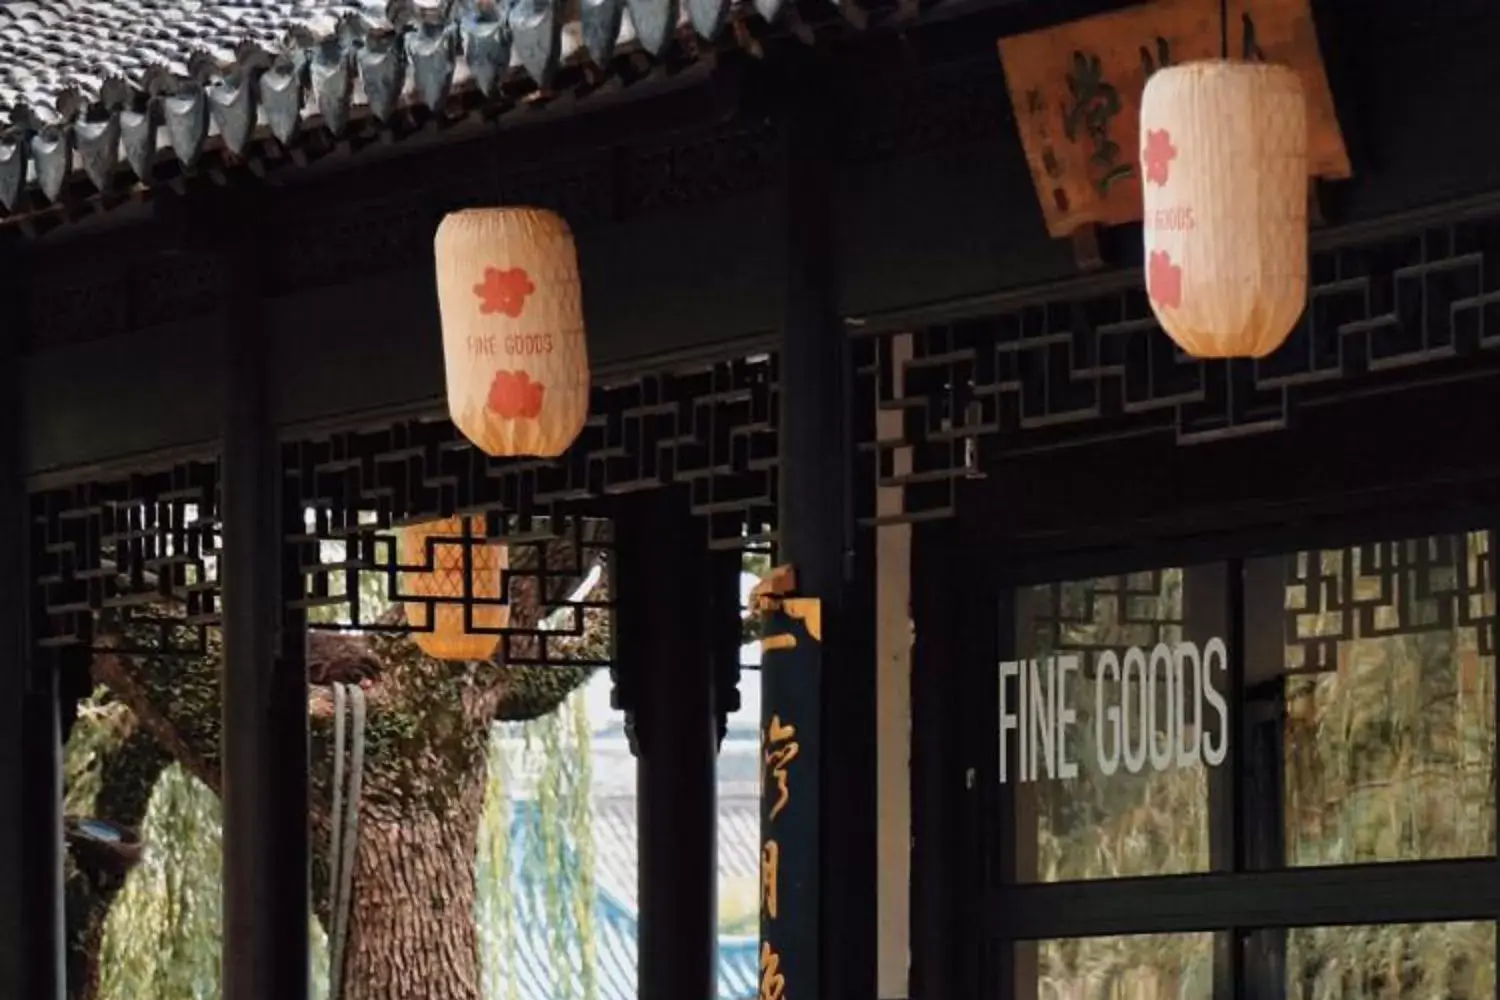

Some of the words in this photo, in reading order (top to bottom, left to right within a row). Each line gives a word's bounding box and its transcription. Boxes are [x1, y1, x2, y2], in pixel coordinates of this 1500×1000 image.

[467, 335, 497, 357] FINE
[504, 332, 554, 355] GOODS
[998, 655, 1079, 784] FINE
[1095, 636, 1229, 776] GOODS
